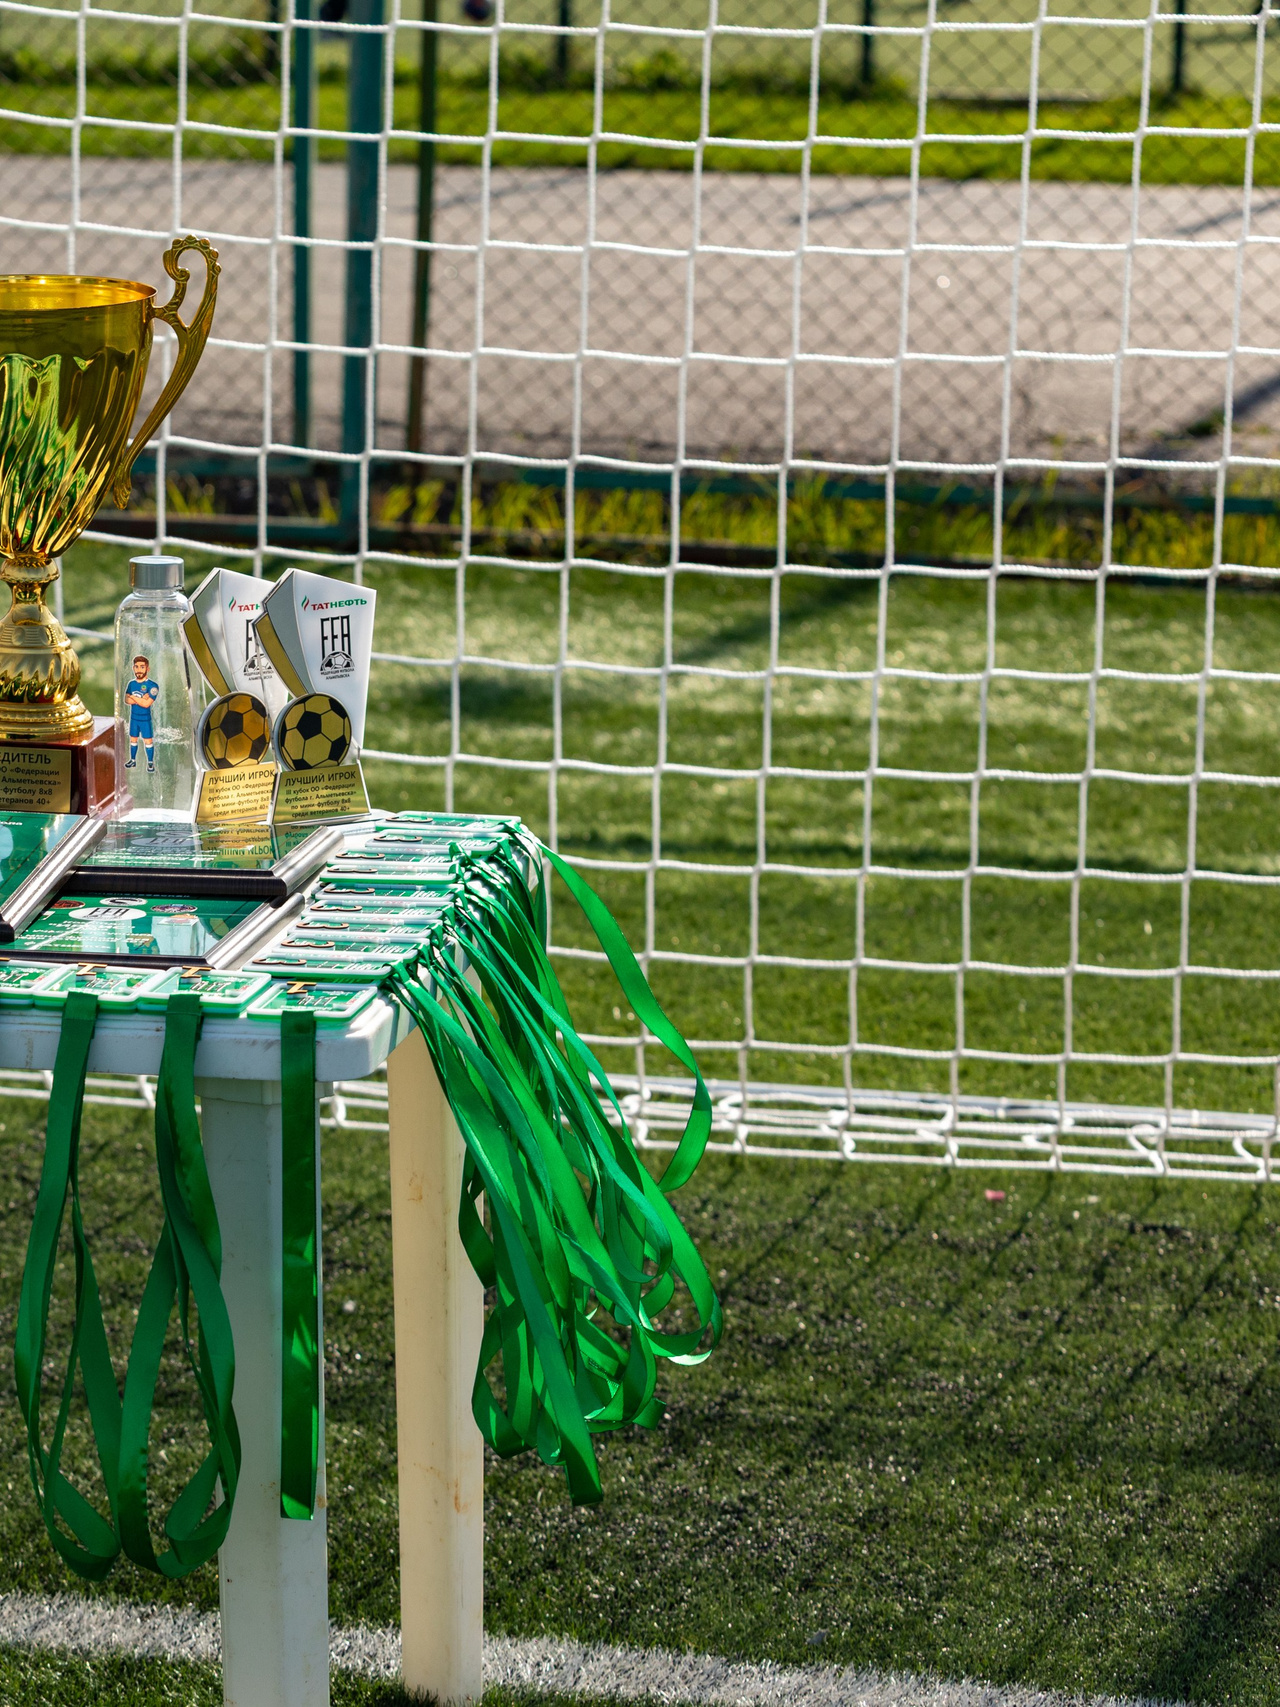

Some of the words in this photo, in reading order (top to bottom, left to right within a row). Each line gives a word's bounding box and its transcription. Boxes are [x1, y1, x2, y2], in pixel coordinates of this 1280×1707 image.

[311, 598, 368, 611] ТАТНЕФТЬ
[10, 767, 60, 777] «Федерации
[1, 776, 61, 787] Альметьевска»
[208, 771, 246, 786] ЛУЧШИЙ
[248, 769, 275, 780] ИГРОК
[285, 773, 325, 787] ЛУЧШИЙ
[328, 771, 356, 781] ИГРОК
[215, 786, 231, 794] кубок
[293, 787, 310, 795] кубок
[208, 794, 230, 803] футбола
[221, 799, 259, 808] мини-футболу
[285, 795, 308, 804] футбола
[300, 800, 341, 809] мини-футболу
[214, 810, 230, 818] среди
[231, 806, 258, 815] ветеранов
[292, 811, 309, 819] среди
[310, 807, 339, 816] ветеранов
